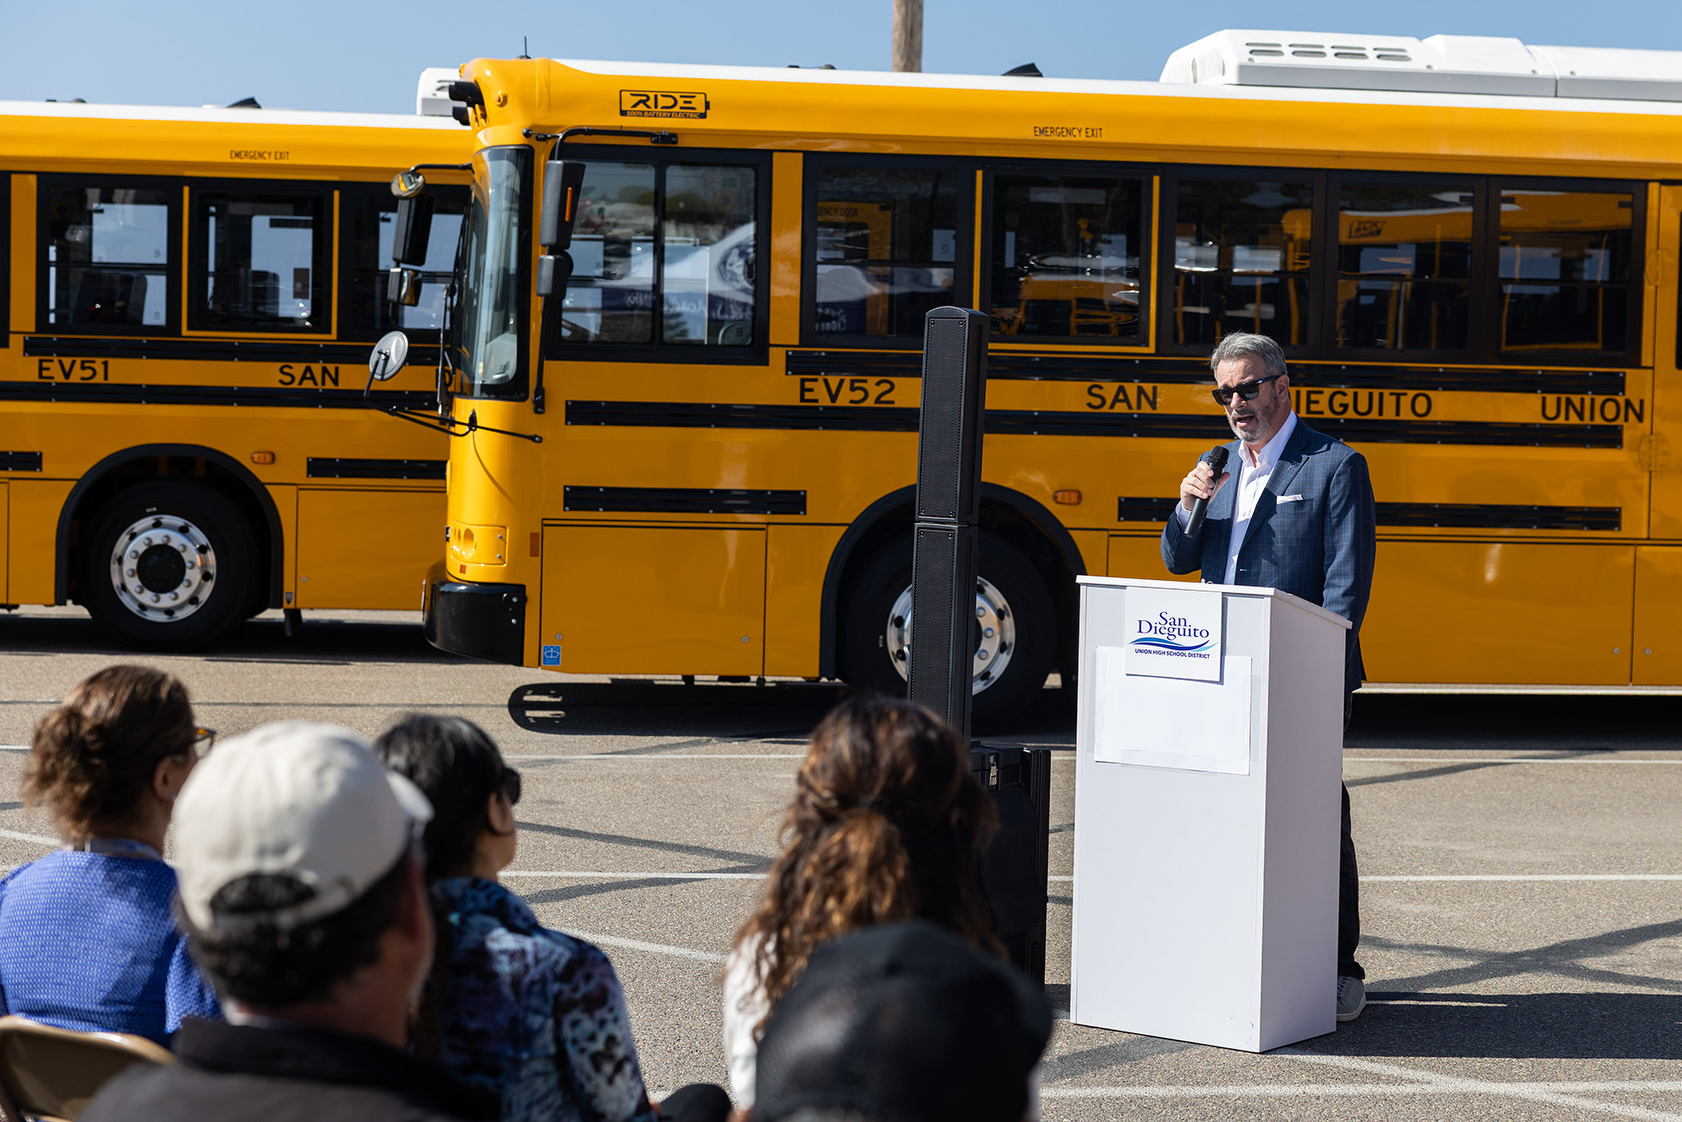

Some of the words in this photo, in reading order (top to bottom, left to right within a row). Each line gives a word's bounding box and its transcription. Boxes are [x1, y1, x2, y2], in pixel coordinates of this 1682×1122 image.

[629, 93, 697, 110] RIDE
[1033, 126, 1083, 138] EMERGENCY
[1085, 127, 1103, 138] EXIT
[230, 150, 272, 160] EMERGENCY
[274, 151, 290, 160] EXIT
[38, 358, 109, 381] EV51
[278, 364, 339, 387] SAN
[799, 377, 896, 405] EV52
[1086, 383, 1158, 411] SAN
[1295, 389, 1433, 418] IEGUITO
[1541, 396, 1645, 423] UNION
[1137, 619, 1210, 640] Dieguito
[1159, 611, 1188, 627] San
